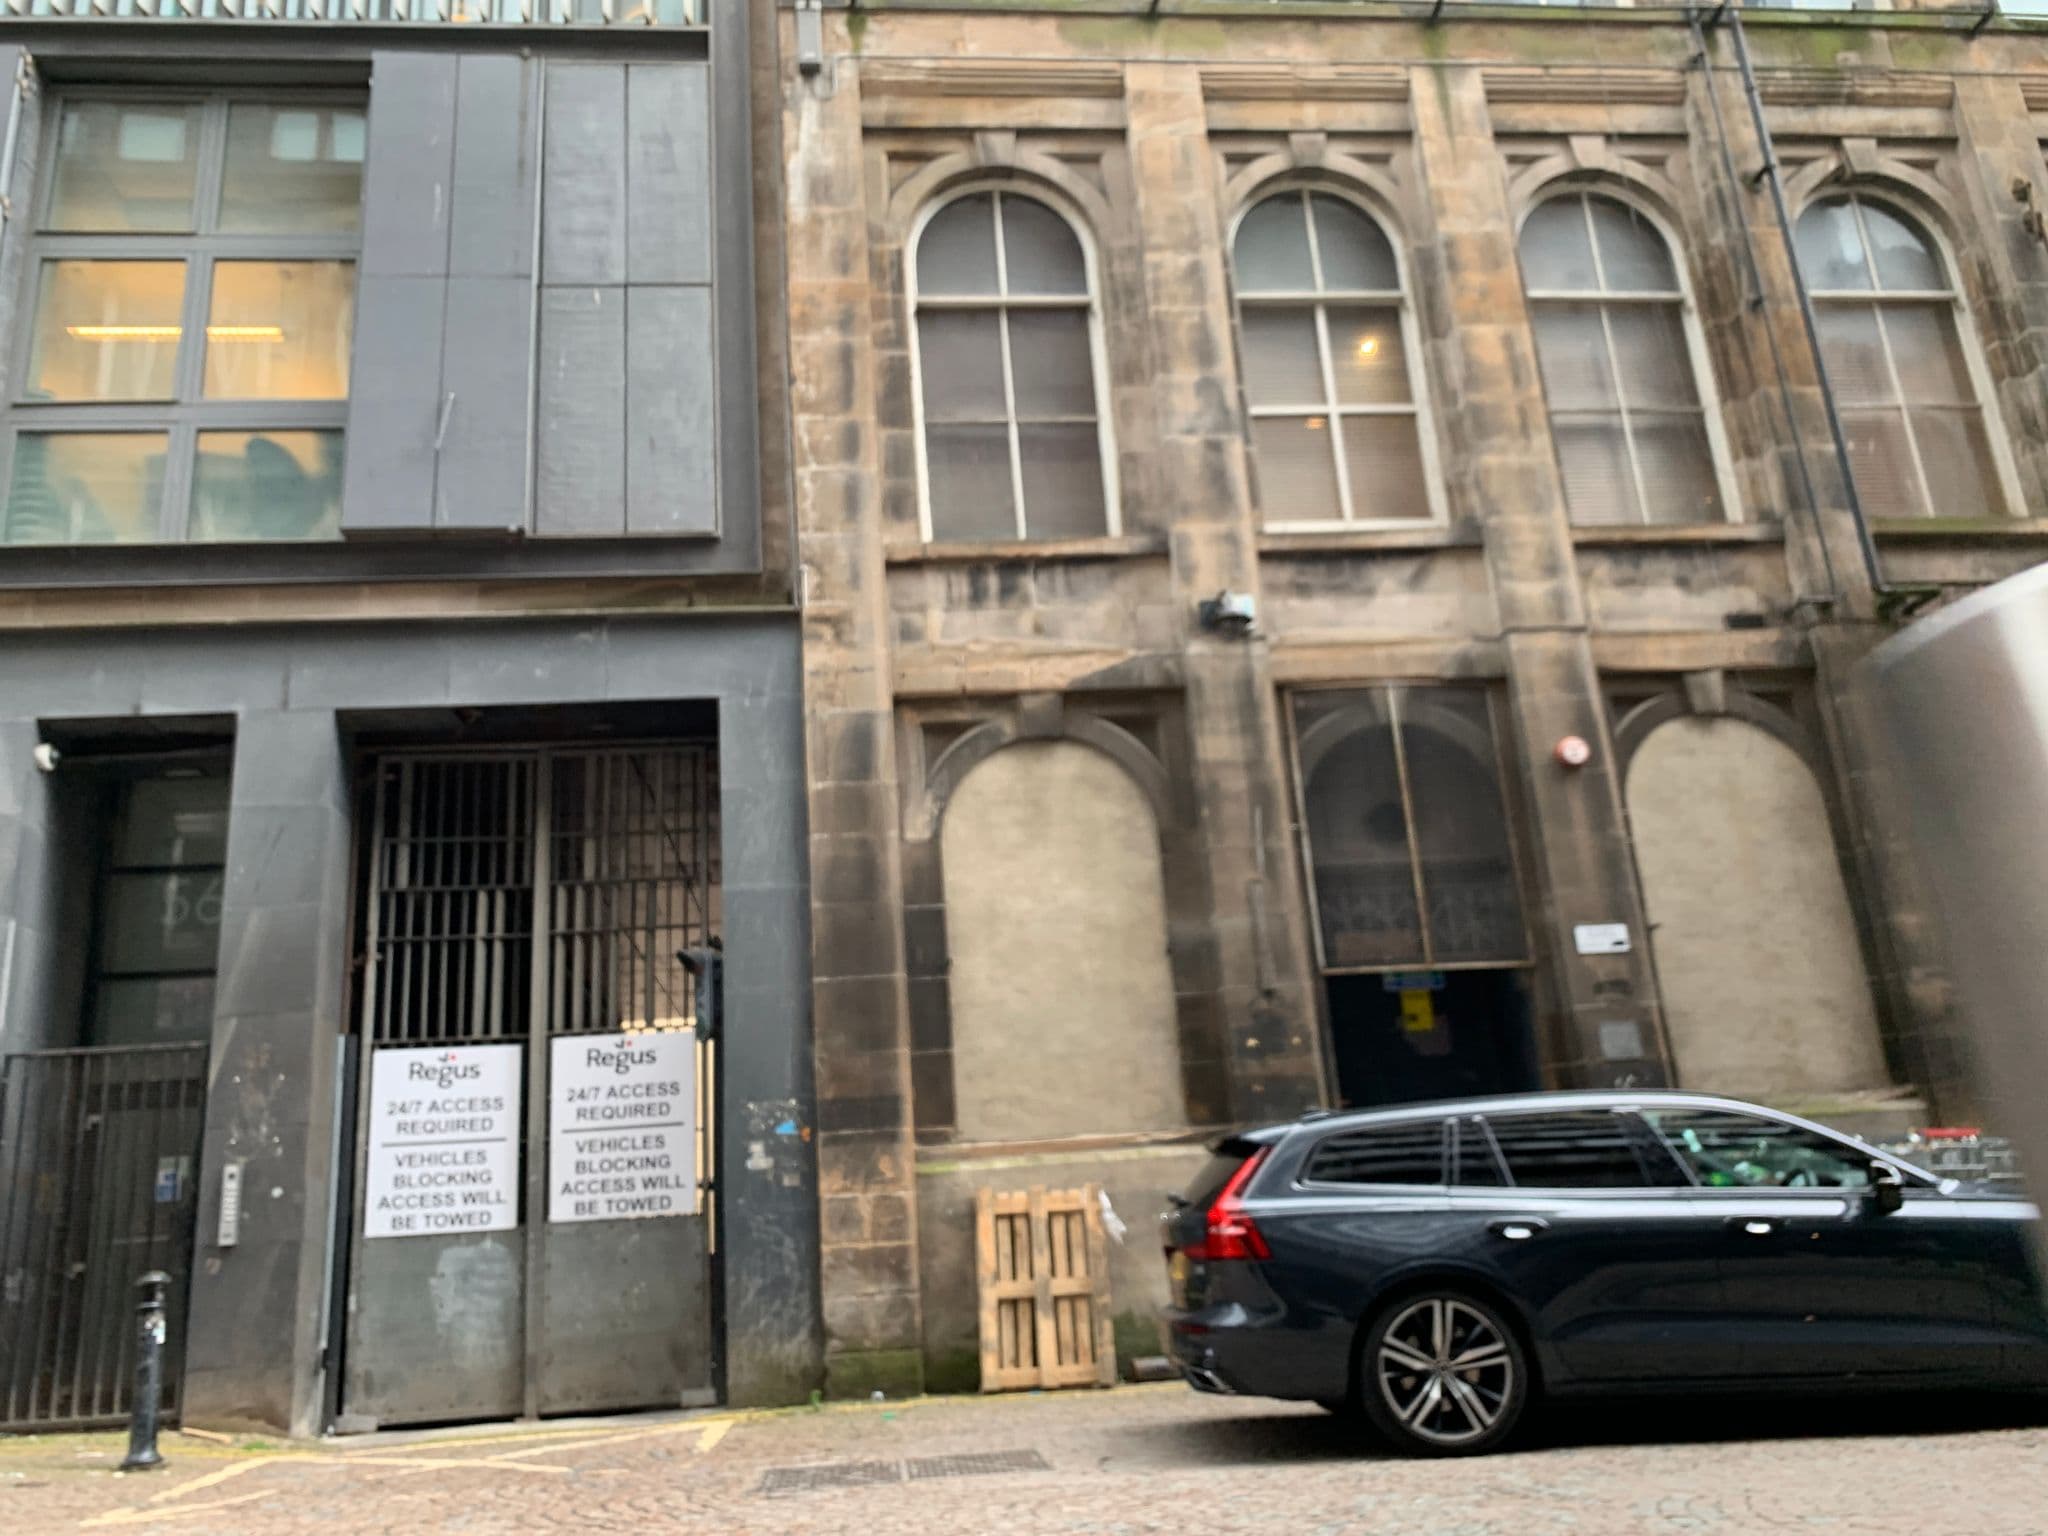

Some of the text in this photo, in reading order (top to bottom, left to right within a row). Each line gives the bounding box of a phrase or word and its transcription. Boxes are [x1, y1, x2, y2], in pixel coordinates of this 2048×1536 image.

[587, 1048, 657, 1074] Regus
[409, 1061, 481, 1089] Regus
[567, 1082, 680, 1102] 24/7 ACCESS
[387, 1097, 504, 1115] 24/7 ACCESS
[576, 1102, 671, 1121] REQUIRED
[396, 1117, 494, 1135] REQUIRED
[576, 1135, 665, 1154] VEHICLES
[395, 1150, 487, 1168] VEHICLES
[575, 1155, 671, 1175] BLOCKING
[393, 1170, 492, 1189] BLOCKING
[561, 1175, 685, 1196] ACCESS WILL
[377, 1190, 506, 1210] ACCESS WILL
[575, 1196, 672, 1216] BE TOWED
[391, 1211, 492, 1231] BE TOWED
